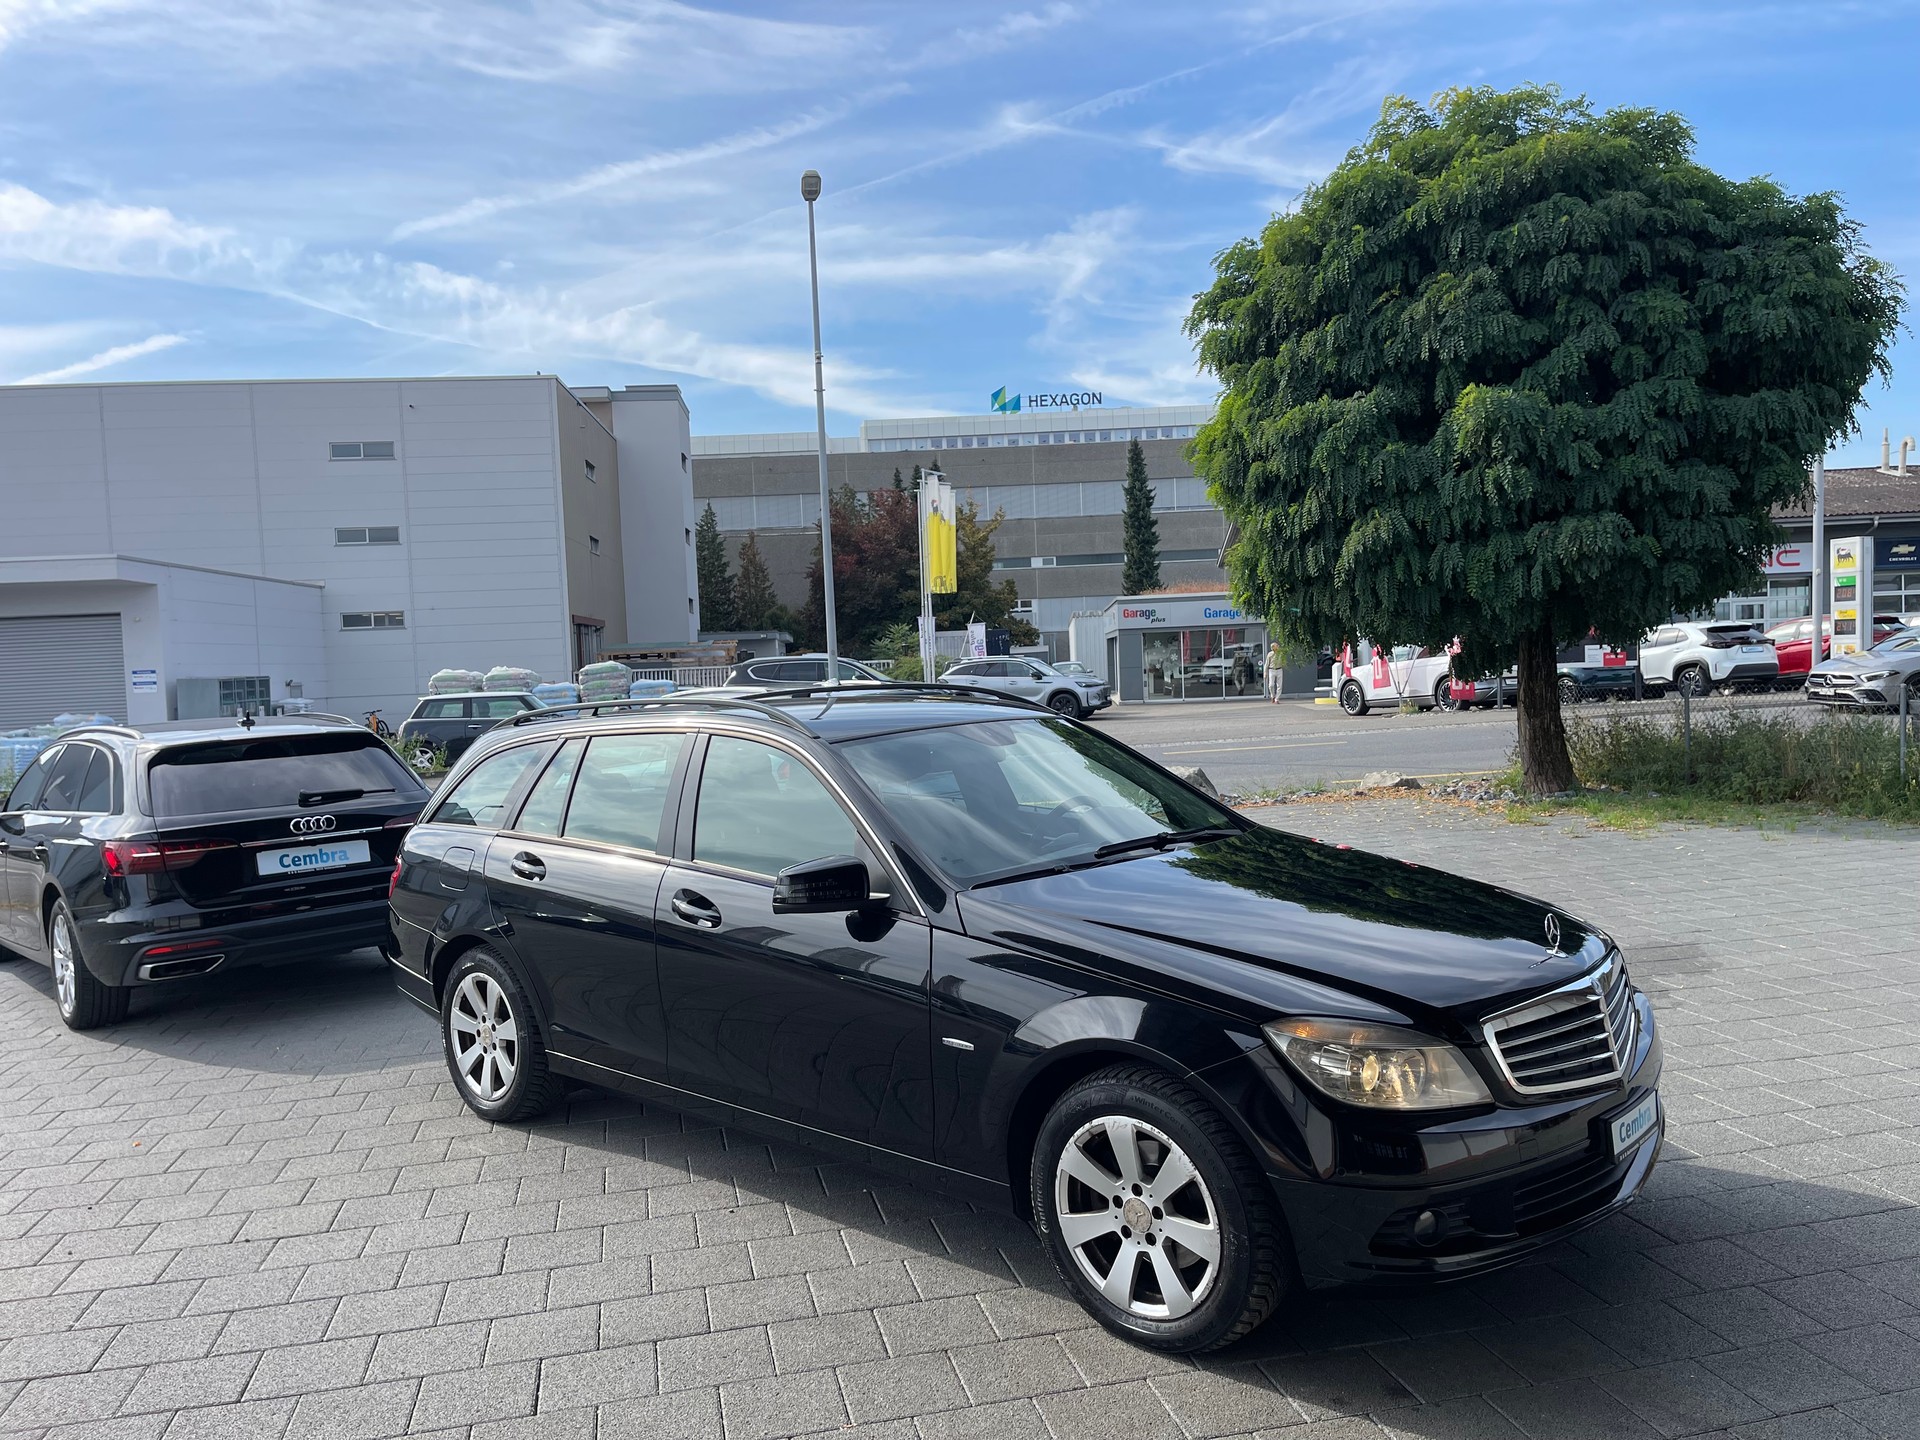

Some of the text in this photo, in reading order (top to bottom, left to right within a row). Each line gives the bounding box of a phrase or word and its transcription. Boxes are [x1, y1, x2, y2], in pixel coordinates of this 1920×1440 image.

[1028, 392, 1102, 408] HEXAGON
[1123, 608, 1156, 620] Garage
[278, 848, 350, 869] Cembra
[1619, 1106, 1651, 1143] Cembra
